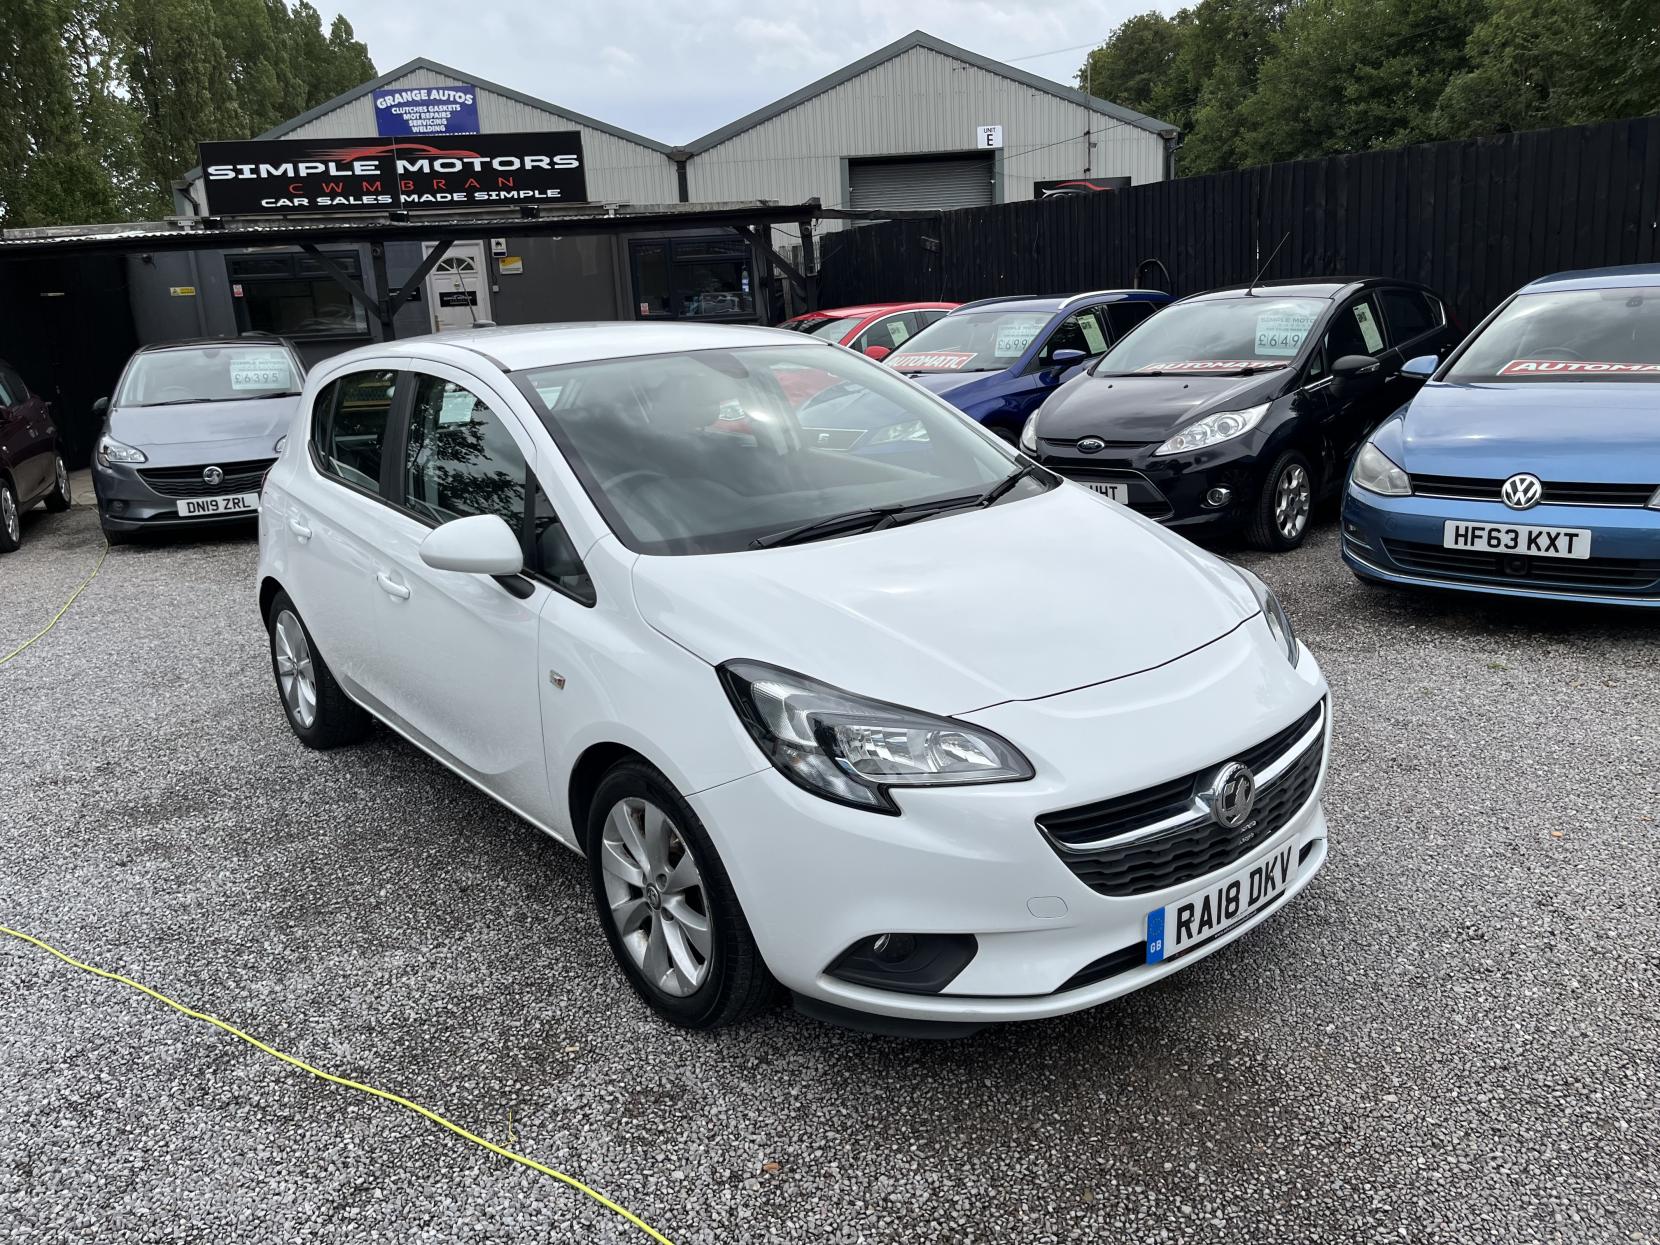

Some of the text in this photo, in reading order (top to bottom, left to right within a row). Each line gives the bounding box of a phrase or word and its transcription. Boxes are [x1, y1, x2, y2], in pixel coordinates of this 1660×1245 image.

[377, 90, 474, 108] GRANGE AUTOS
[391, 104, 461, 114] CLUTCHES GASKETS
[408, 118, 447, 126] SERVICING
[986, 133, 994, 146] E
[207, 154, 580, 180] SIMPLE MOTORS
[261, 189, 561, 207] CAR SALES MADE SIMPLE
[999, 338, 1028, 350] £699
[1258, 333, 1300, 347] £649
[1511, 361, 1660, 371] AUTOMA
[234, 372, 279, 384] £6395
[186, 497, 251, 514] DN19 ZRL
[1454, 525, 1580, 554] HF63 KXT
[1175, 879, 1241, 946] RA18
[1247, 845, 1292, 908] DKV
[1150, 939, 1162, 953] GB
